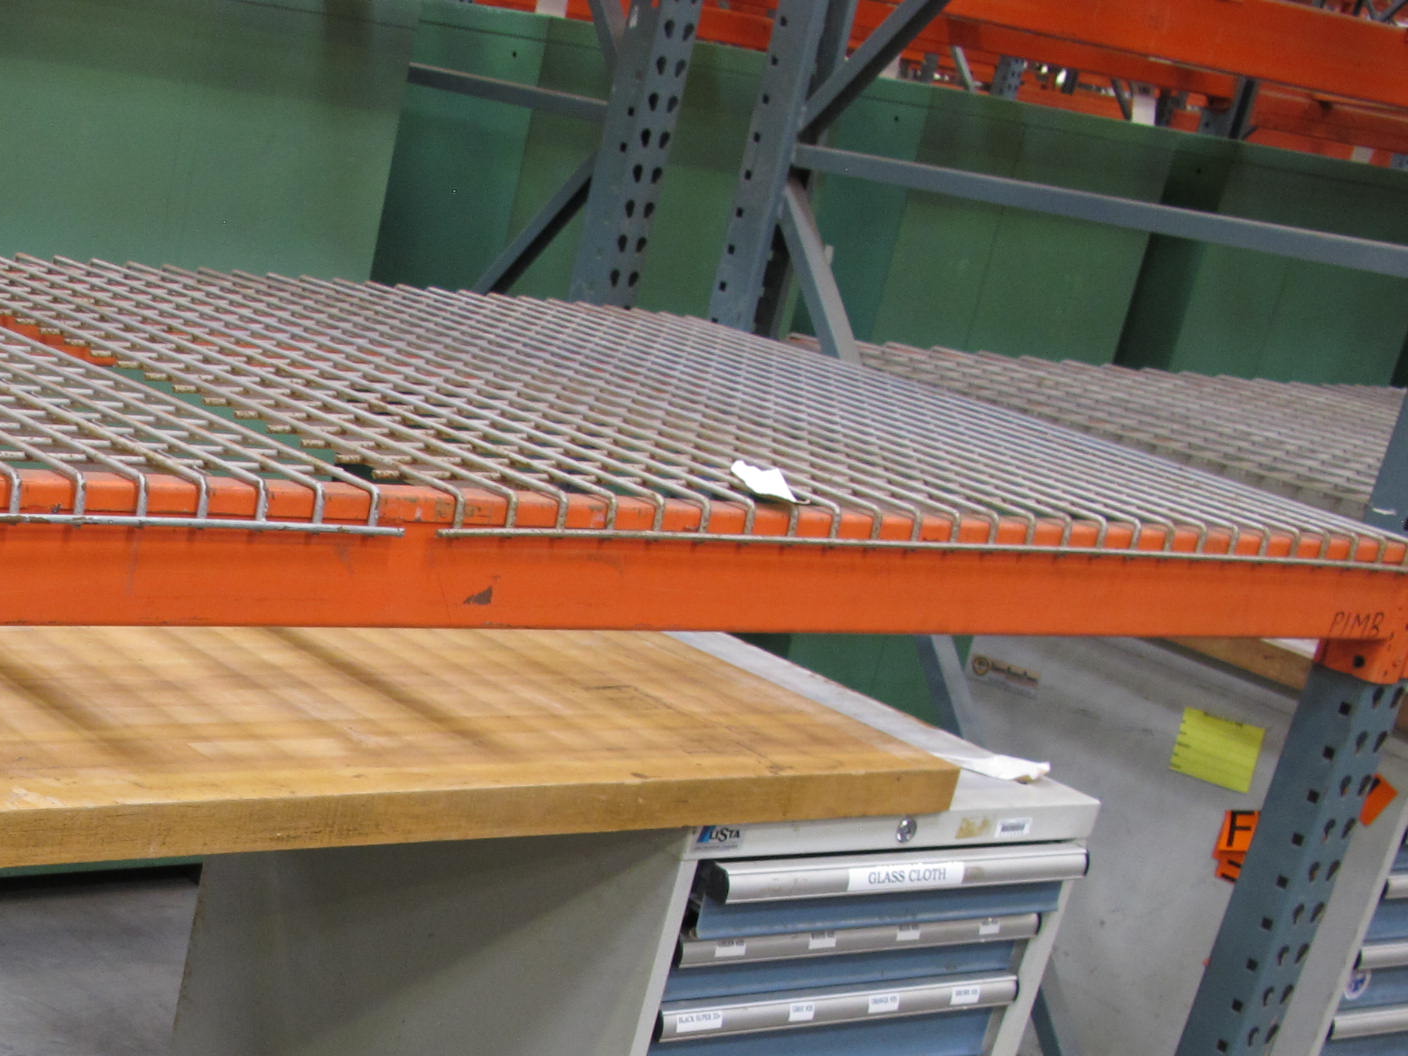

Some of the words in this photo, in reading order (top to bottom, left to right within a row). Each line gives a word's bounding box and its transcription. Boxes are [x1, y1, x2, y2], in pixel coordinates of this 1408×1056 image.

[708, 827, 741, 842] LISTA
[868, 869, 905, 885] GLASS
[908, 867, 947, 882] CLOTH
